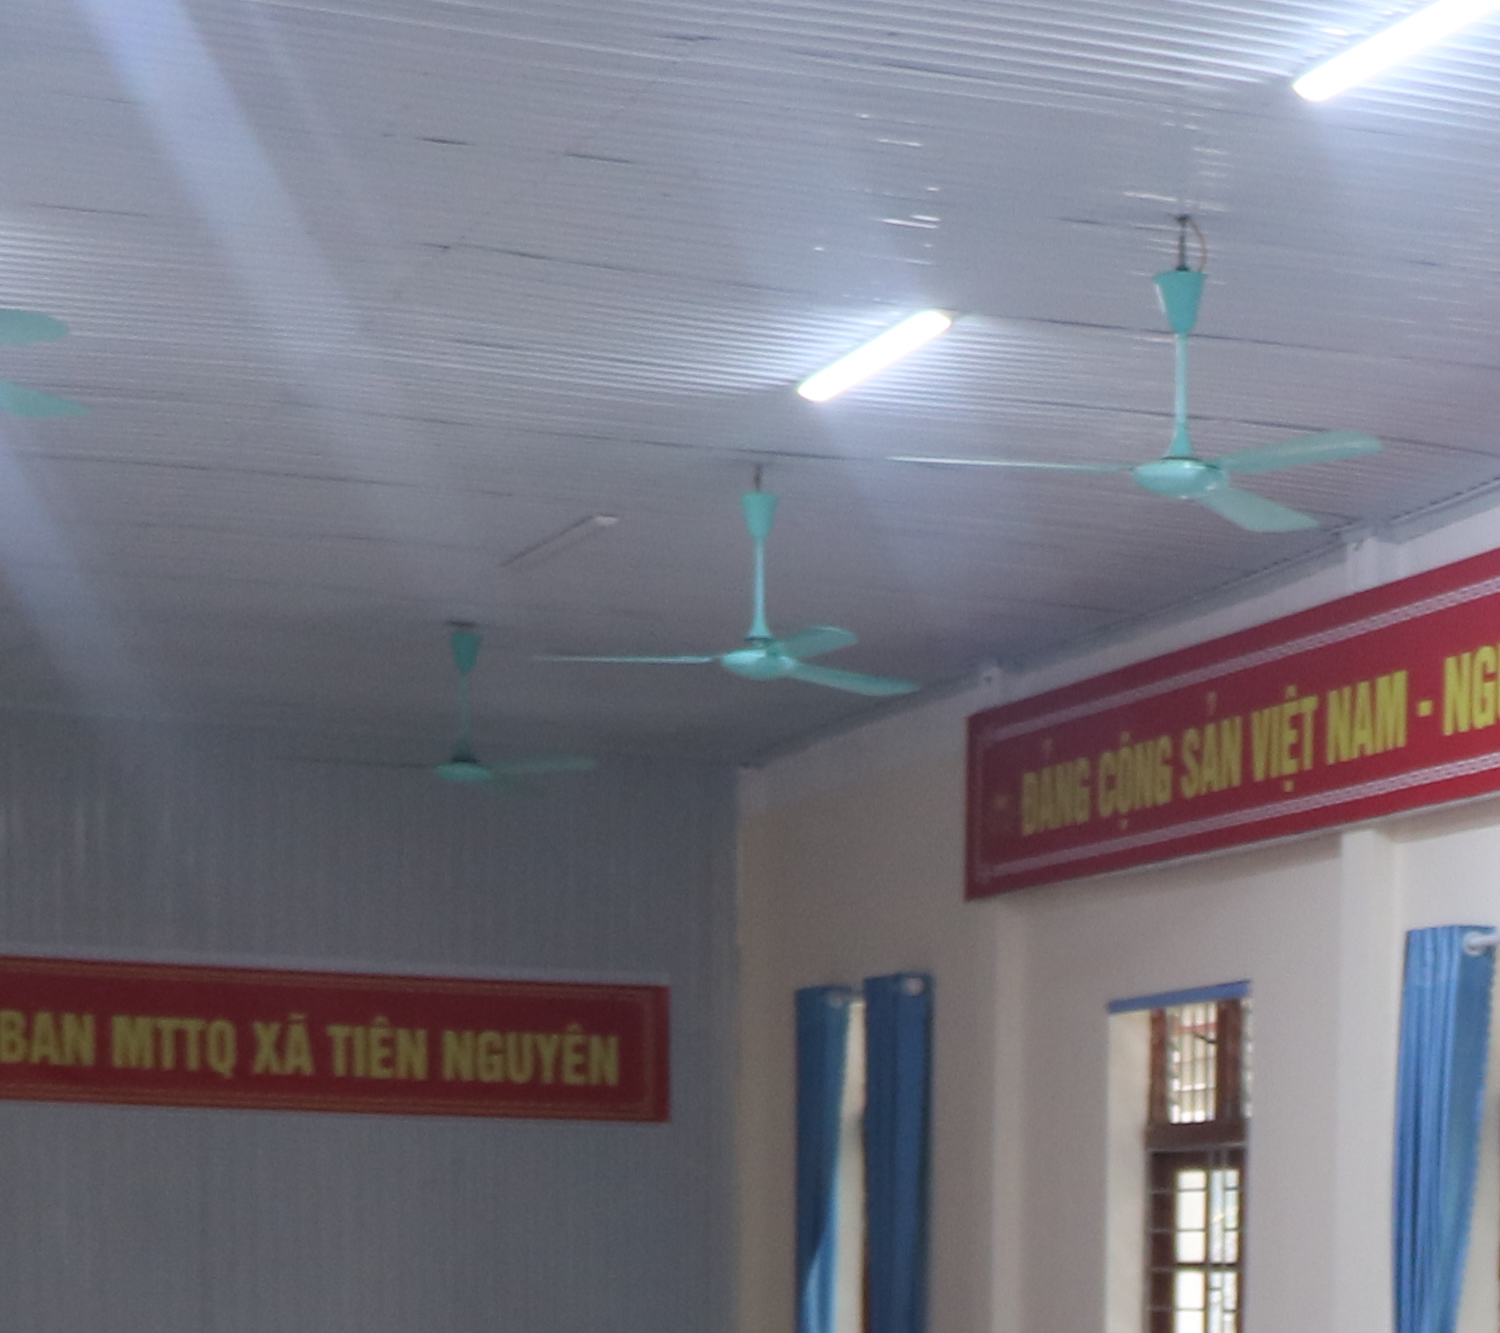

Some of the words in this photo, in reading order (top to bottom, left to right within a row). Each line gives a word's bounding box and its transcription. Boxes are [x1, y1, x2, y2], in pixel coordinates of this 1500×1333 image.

[1021, 738, 1092, 836] ĐẢNG
[1099, 732, 1173, 830] CỘNG
[1181, 692, 1243, 799] SẢN
[1251, 685, 1319, 793] VIỆT
[1325, 669, 1410, 765] NAM
[110, 1014, 237, 1078] MTTQ
[252, 1012, 315, 1075] XÃ
[326, 1015, 429, 1080] TIÊN
[441, 1023, 620, 1086] NGUYÊN
